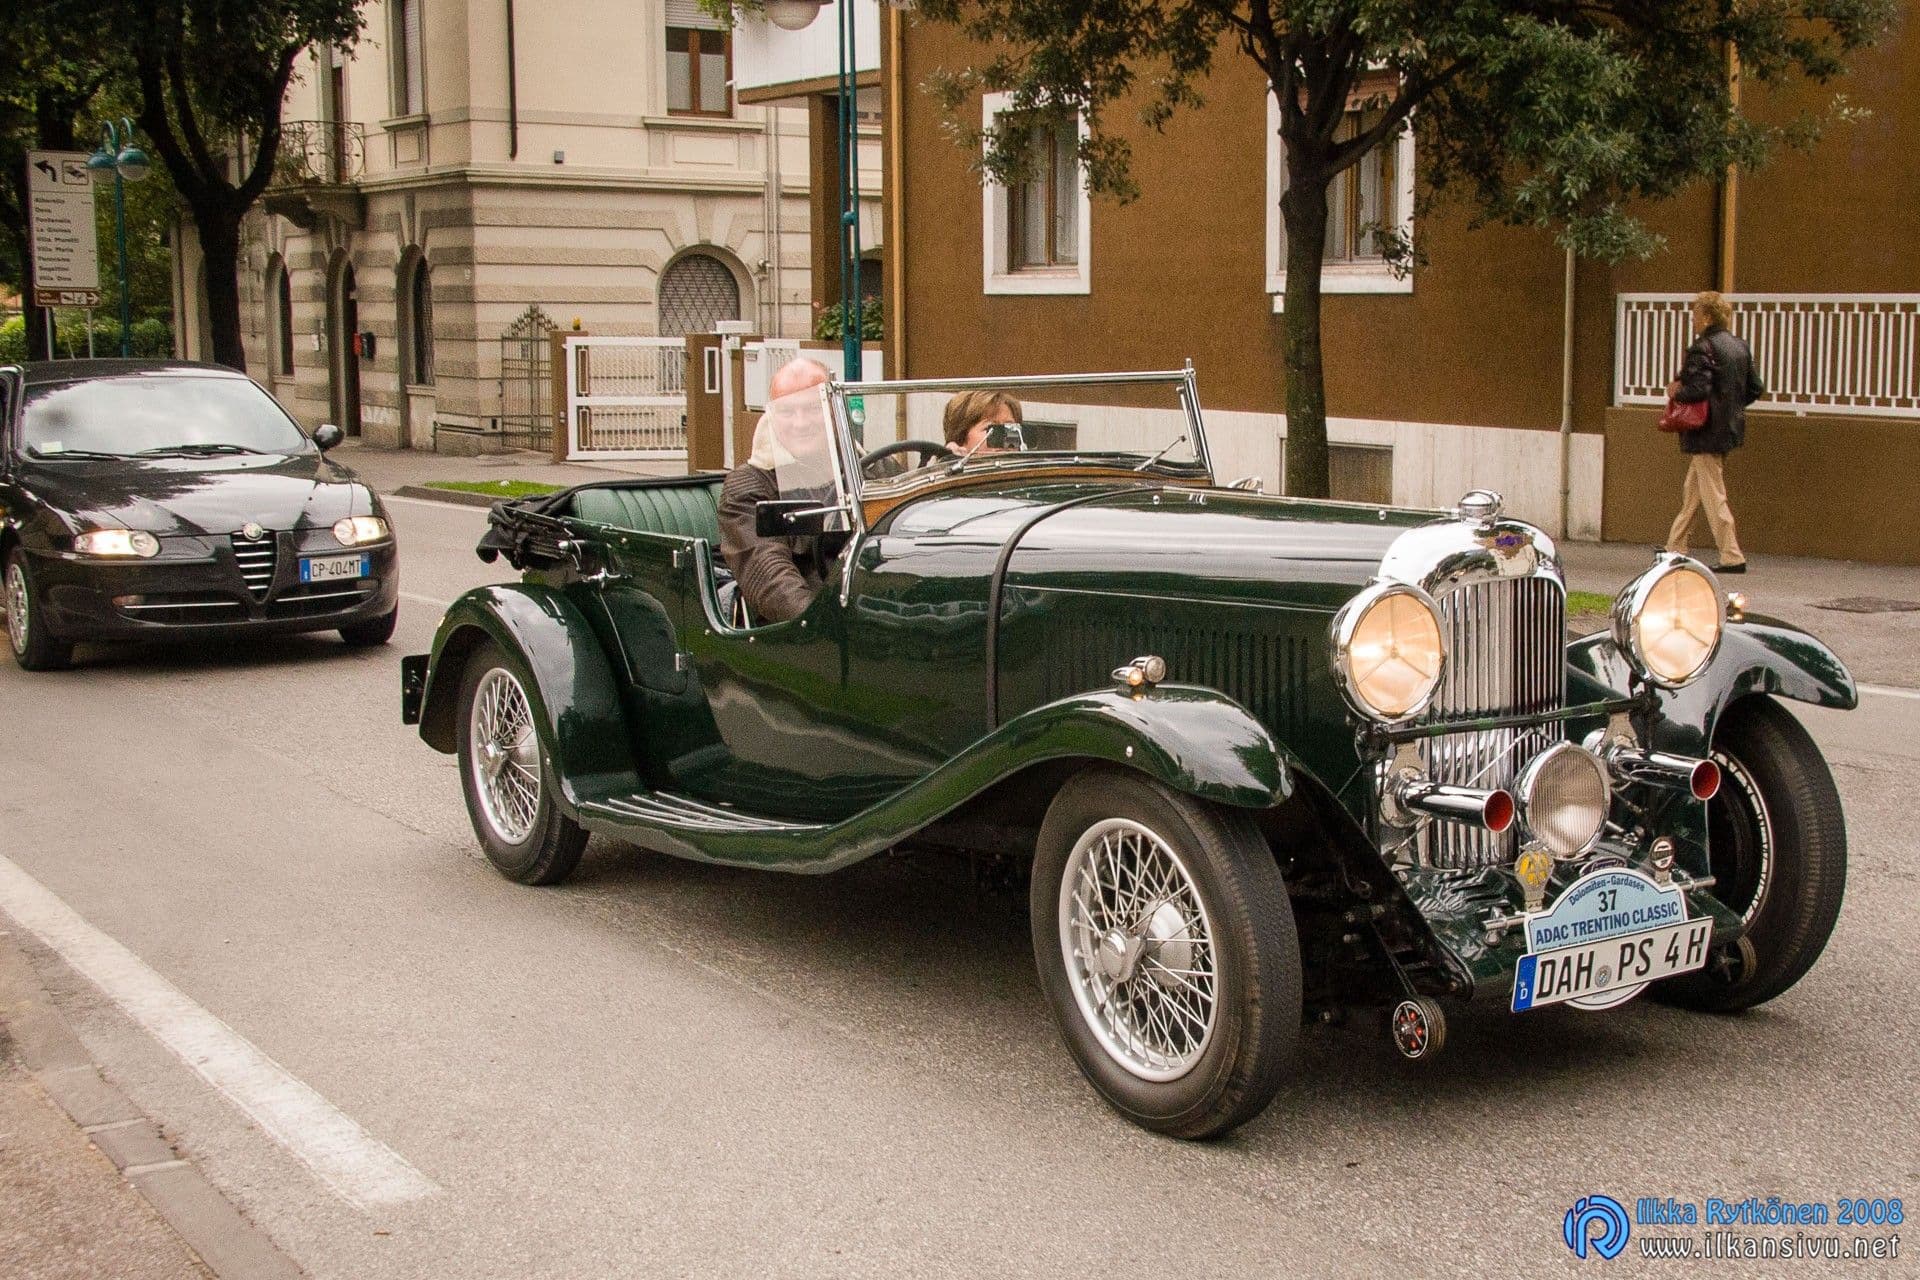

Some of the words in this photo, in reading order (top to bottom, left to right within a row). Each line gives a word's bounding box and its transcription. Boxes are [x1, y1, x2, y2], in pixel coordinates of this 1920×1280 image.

[1535, 925, 1570, 946] ADAC
[1571, 913, 1630, 938] TRENTINO
[1632, 901, 1679, 924] CLASSIC
[1598, 889, 1618, 913] 37
[1536, 950, 1595, 999] DAH
[1617, 937, 1654, 981] PS
